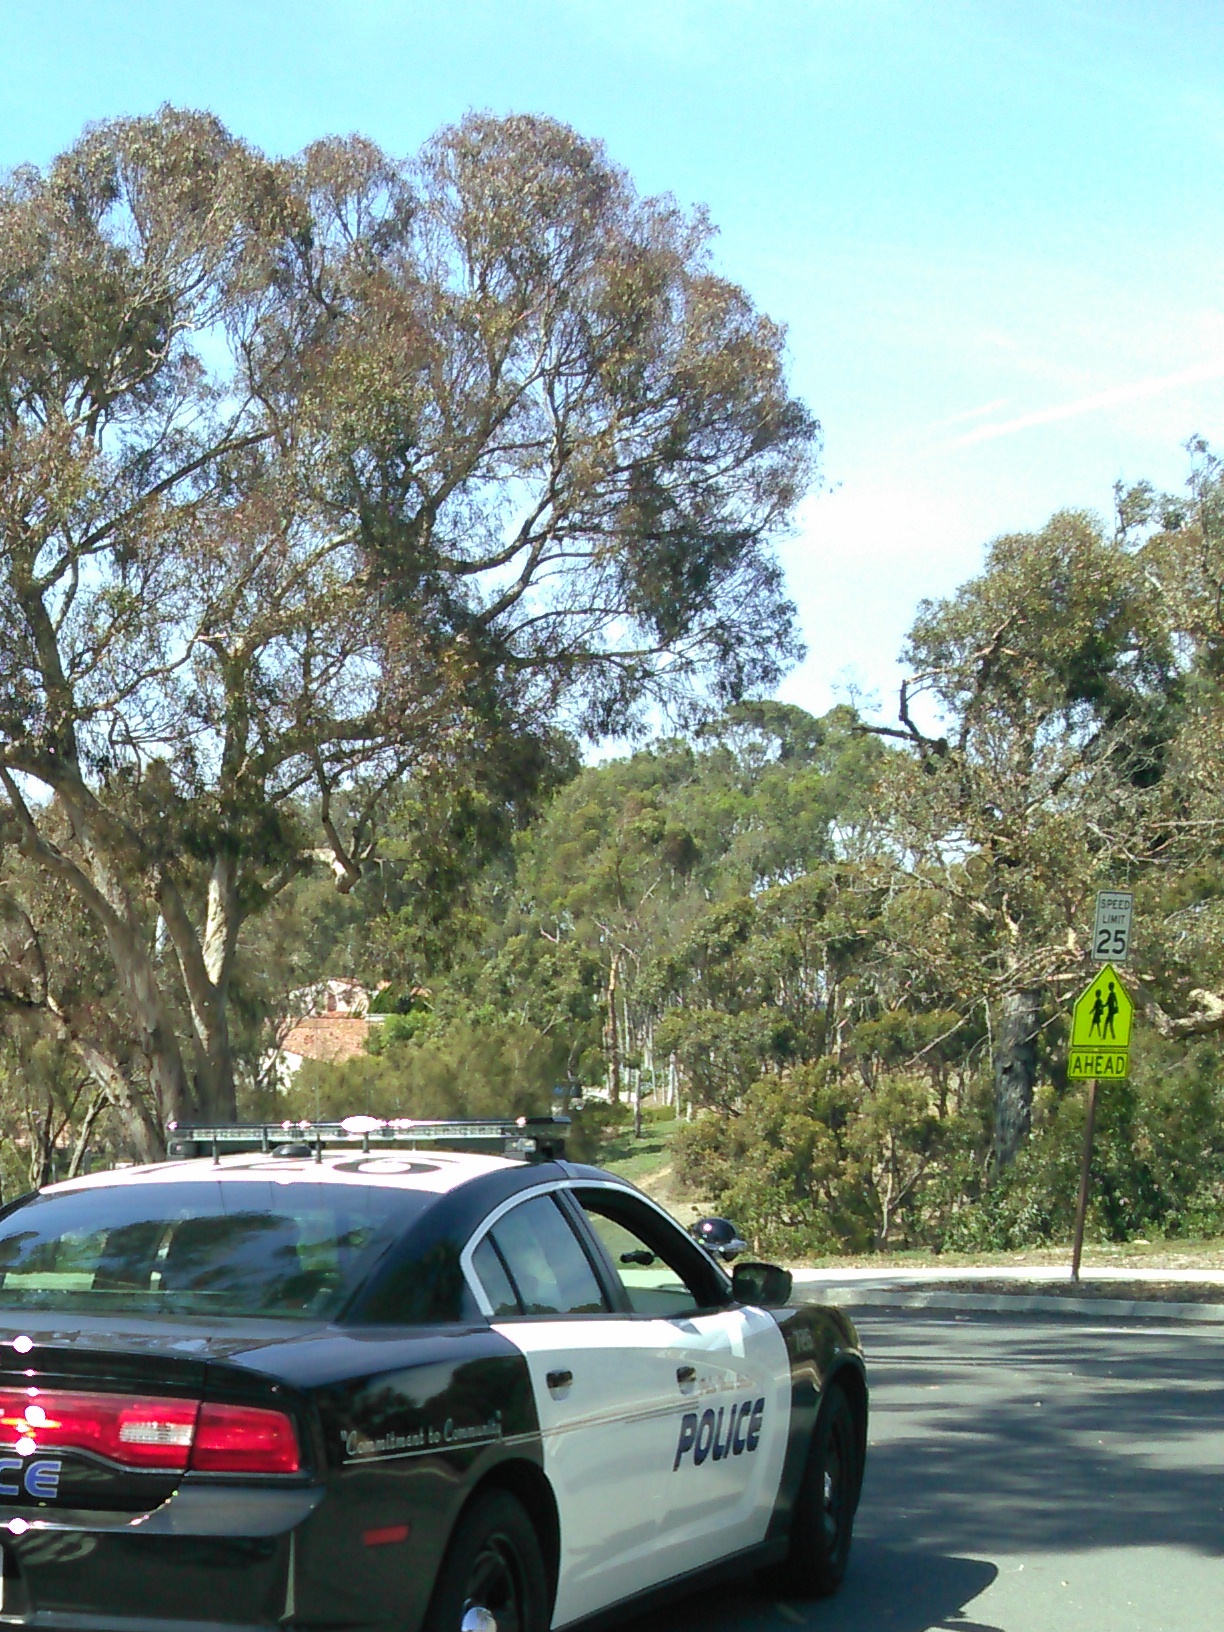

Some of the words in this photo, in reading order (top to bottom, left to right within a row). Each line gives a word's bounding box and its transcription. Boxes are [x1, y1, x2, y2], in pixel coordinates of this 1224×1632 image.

[1100, 898, 1131, 911] SPEED
[1101, 914, 1126, 924] LIMIT
[1096, 929, 1126, 954] 25
[1072, 1056, 1125, 1075] AHEAD
[672, 1396, 766, 1473] POLICE
